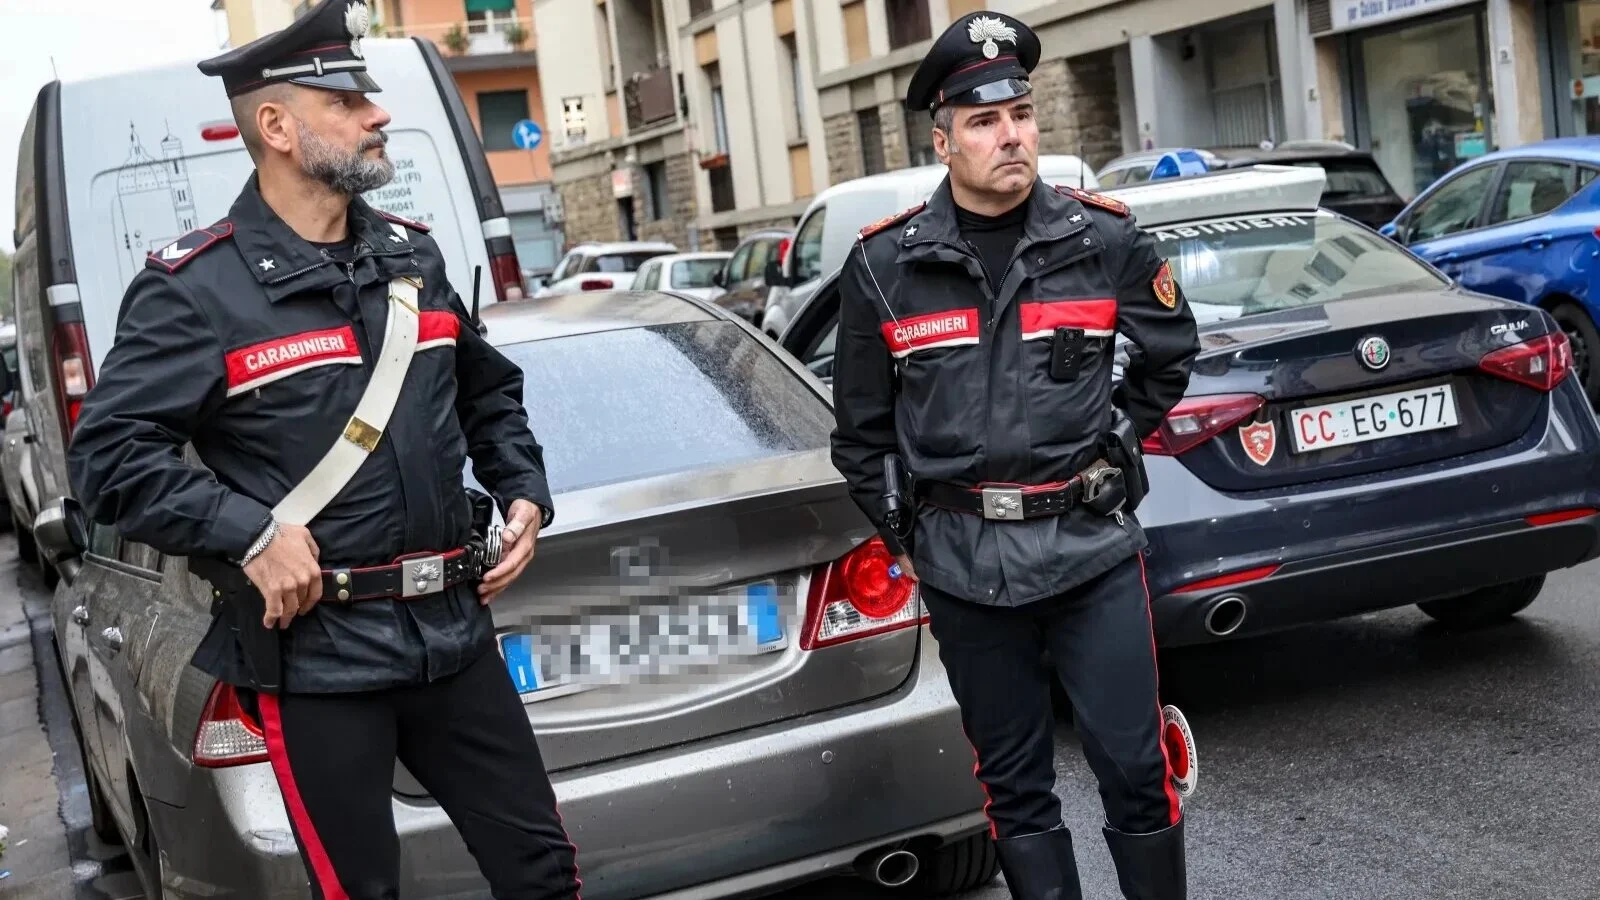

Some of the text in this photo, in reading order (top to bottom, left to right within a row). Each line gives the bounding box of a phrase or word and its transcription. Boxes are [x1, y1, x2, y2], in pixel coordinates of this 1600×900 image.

[1155, 216, 1308, 242] ABINIERI
[893, 315, 968, 343] CARABINIERI
[245, 334, 347, 371] CARABINIERI
[1299, 391, 1446, 445] CC EG 677
